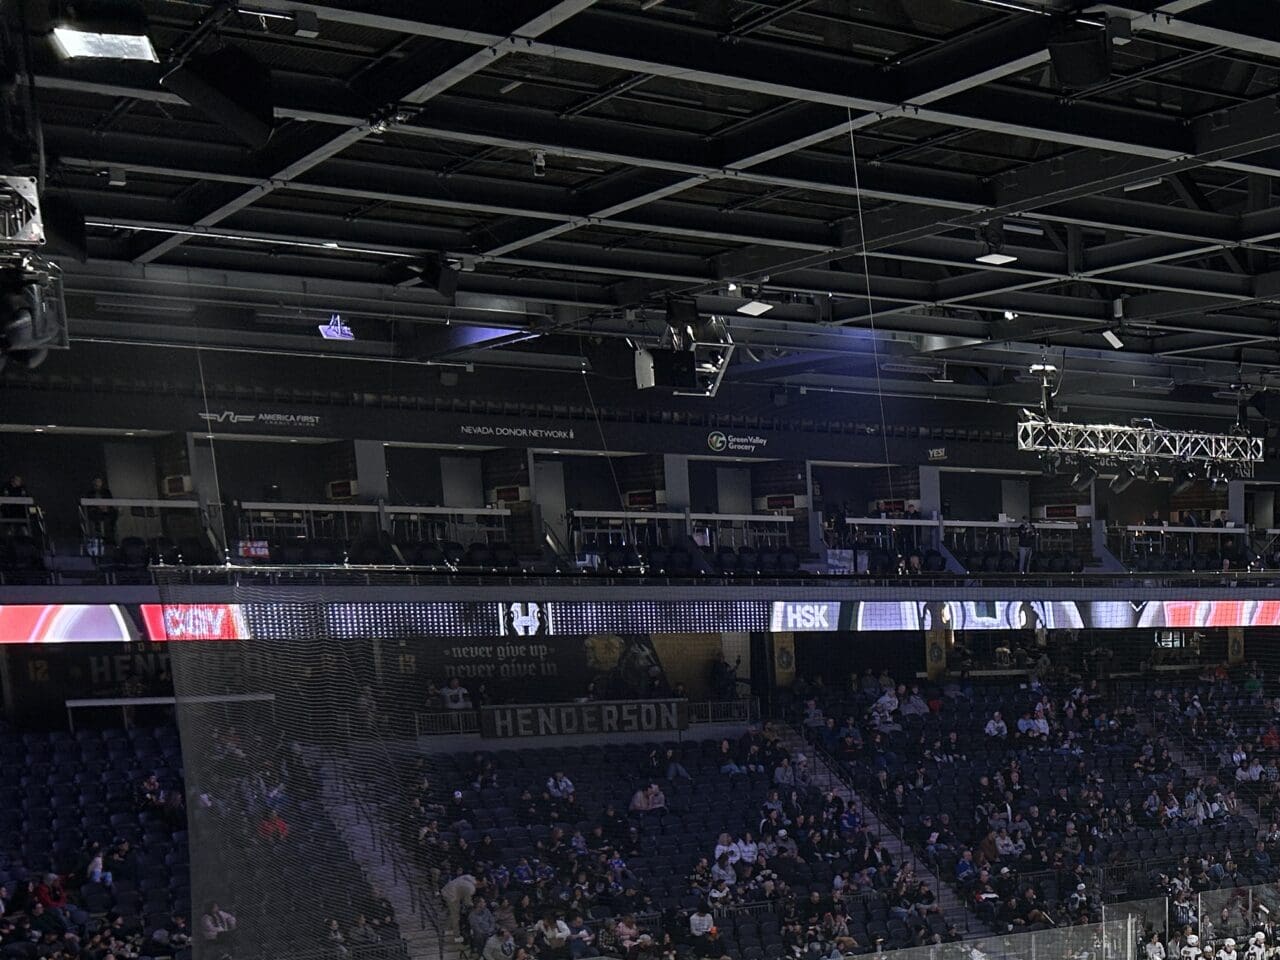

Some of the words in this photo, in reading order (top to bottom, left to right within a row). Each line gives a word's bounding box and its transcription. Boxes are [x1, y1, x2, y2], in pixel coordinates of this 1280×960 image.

[461, 425, 494, 435] NEVADA
[495, 427, 527, 437] DONOR
[528, 429, 568, 439] NETWORK
[787, 604, 829, 628] HSK
[494, 701, 679, 738] HENDERSON
